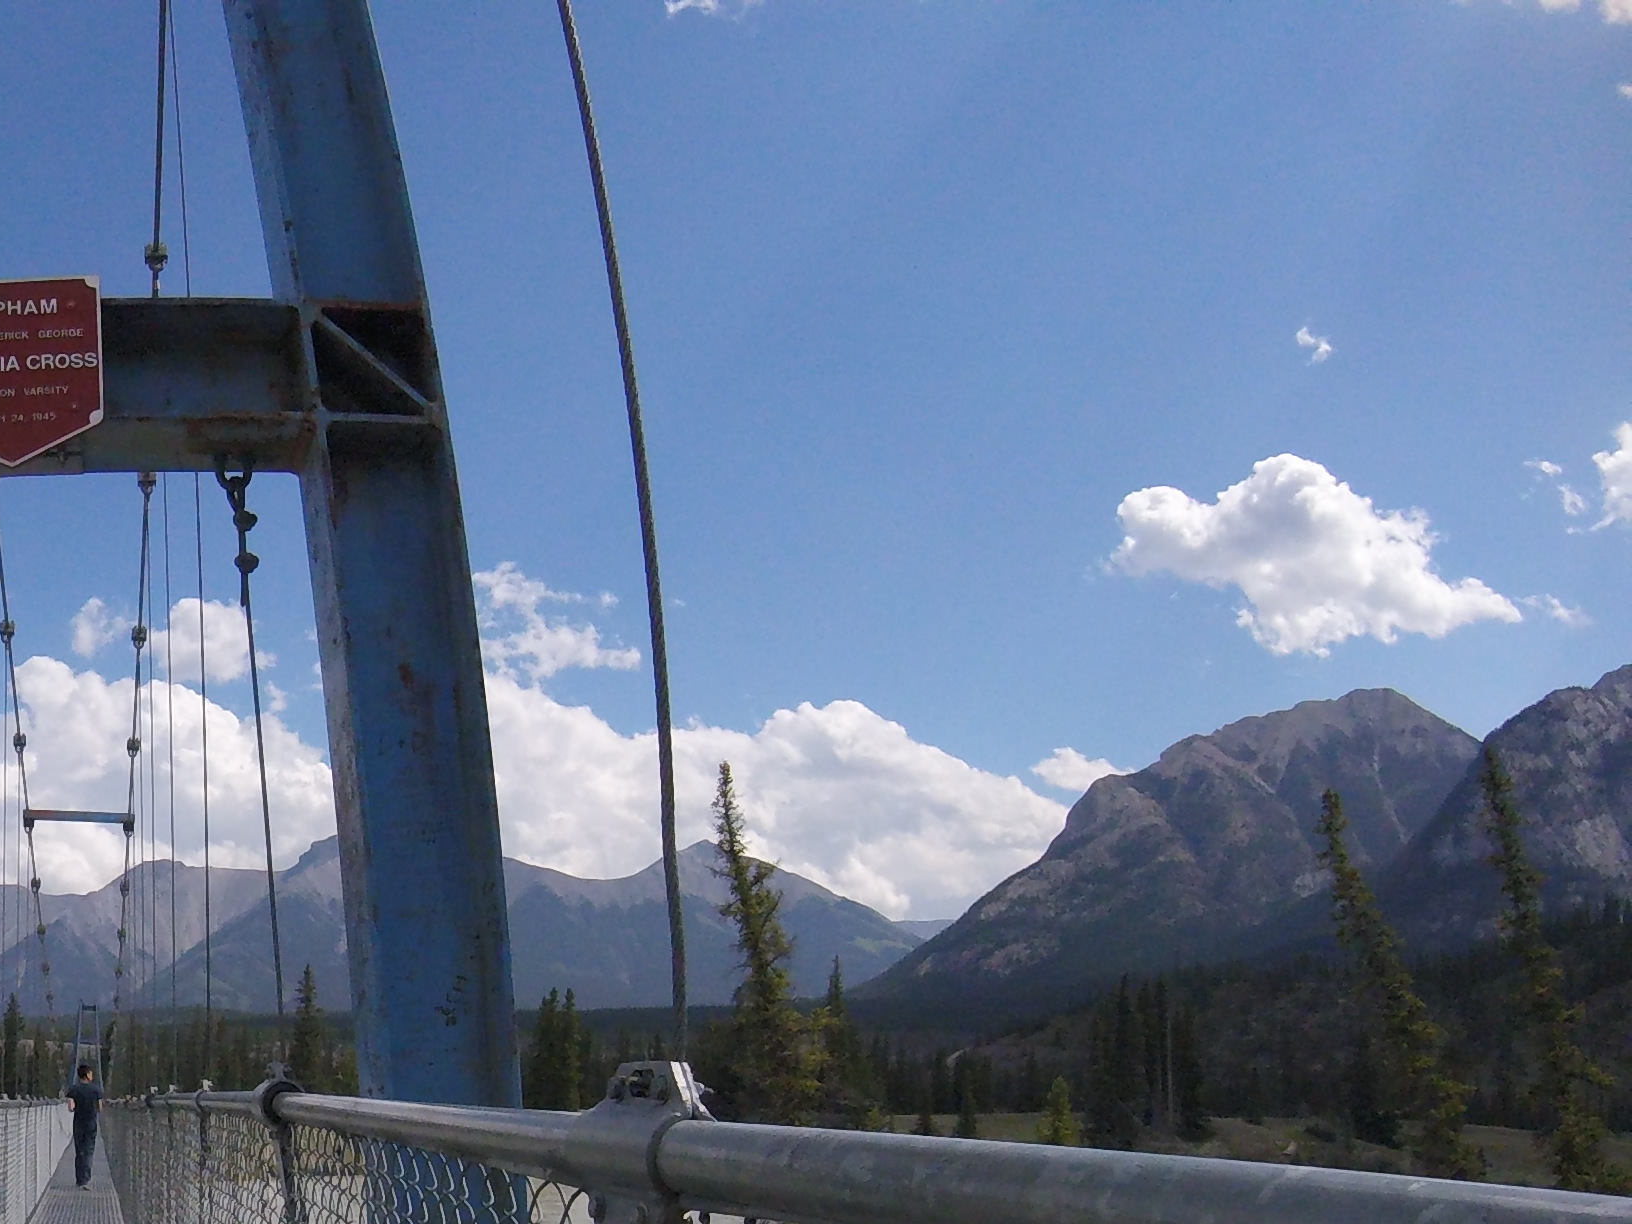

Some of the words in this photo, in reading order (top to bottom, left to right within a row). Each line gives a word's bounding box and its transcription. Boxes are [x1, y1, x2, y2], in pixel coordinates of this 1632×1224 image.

[38, 329, 83, 340] GEORGE
[26, 353, 98, 370] CROSS
[23, 386, 69, 397] VARSITY
[32, 412, 56, 421] 1945
